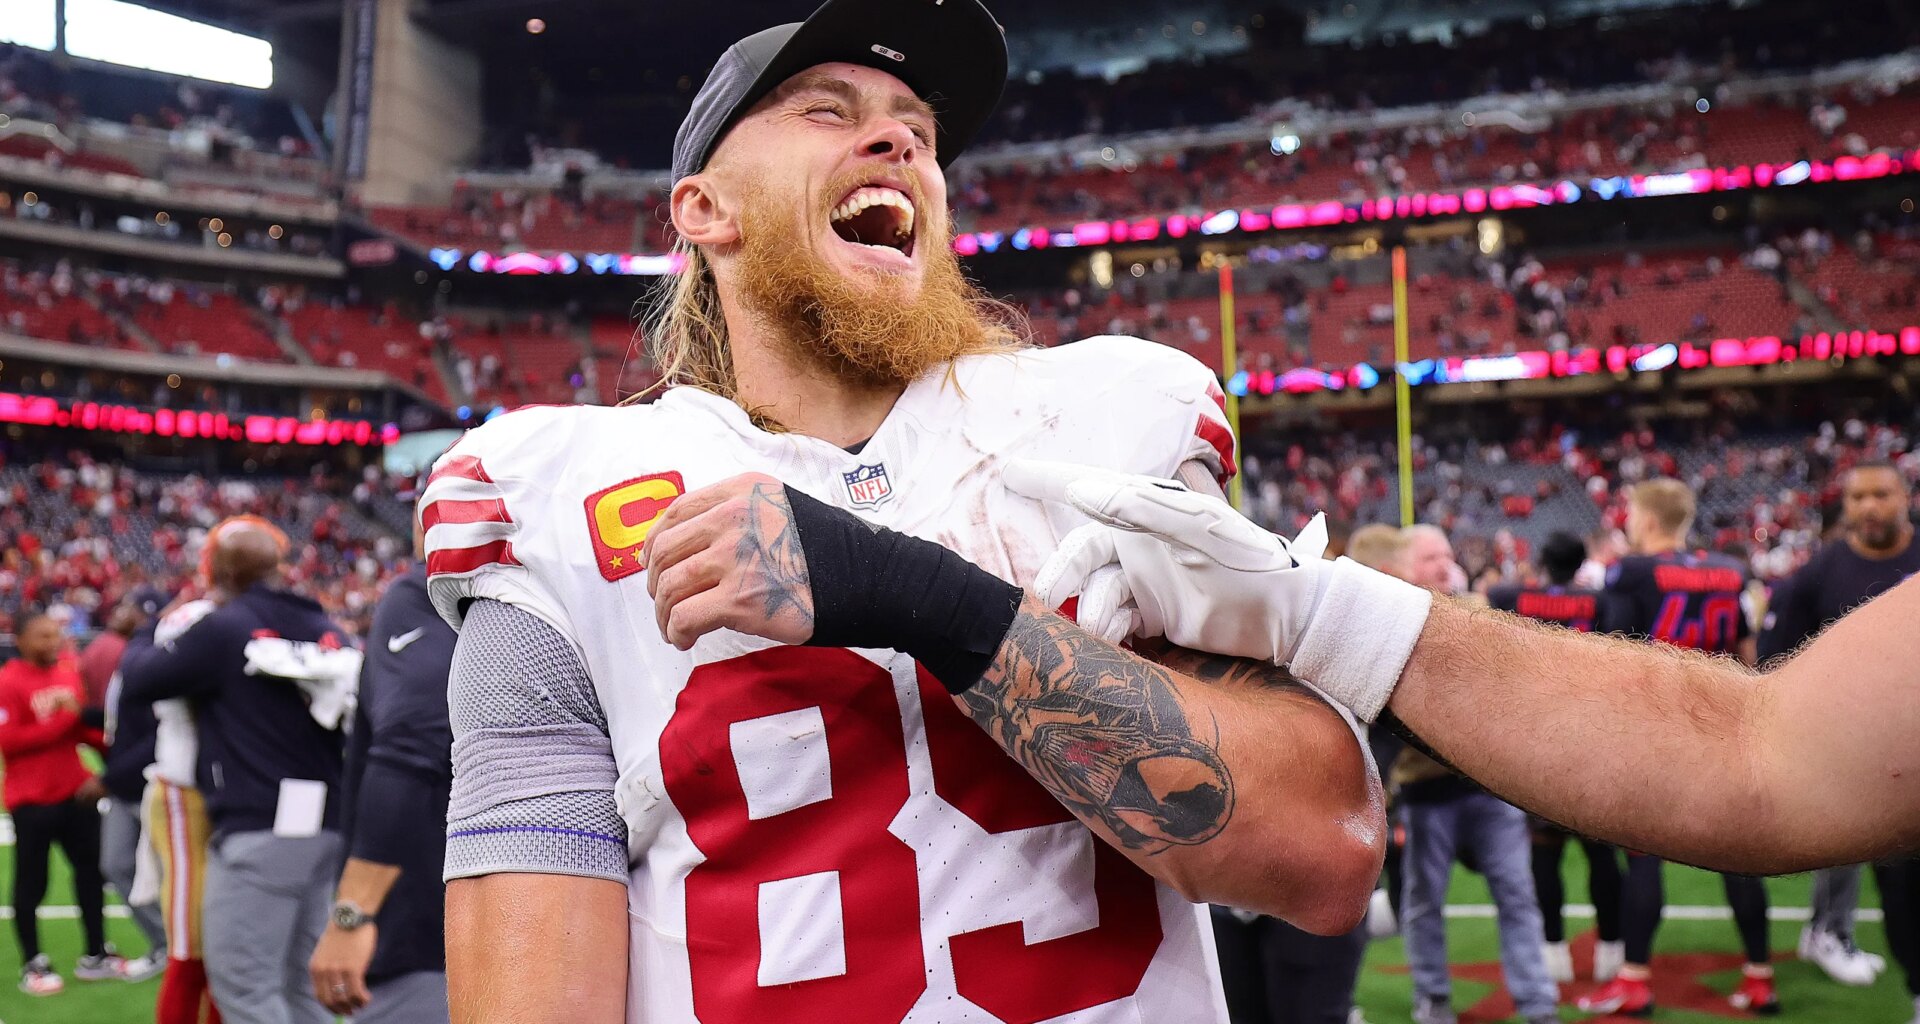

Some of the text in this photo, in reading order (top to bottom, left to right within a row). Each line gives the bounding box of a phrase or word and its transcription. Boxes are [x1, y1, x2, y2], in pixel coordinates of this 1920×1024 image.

[594, 478, 679, 549] C
[851, 478, 888, 501] NFL
[659, 646, 1164, 1024] 85
